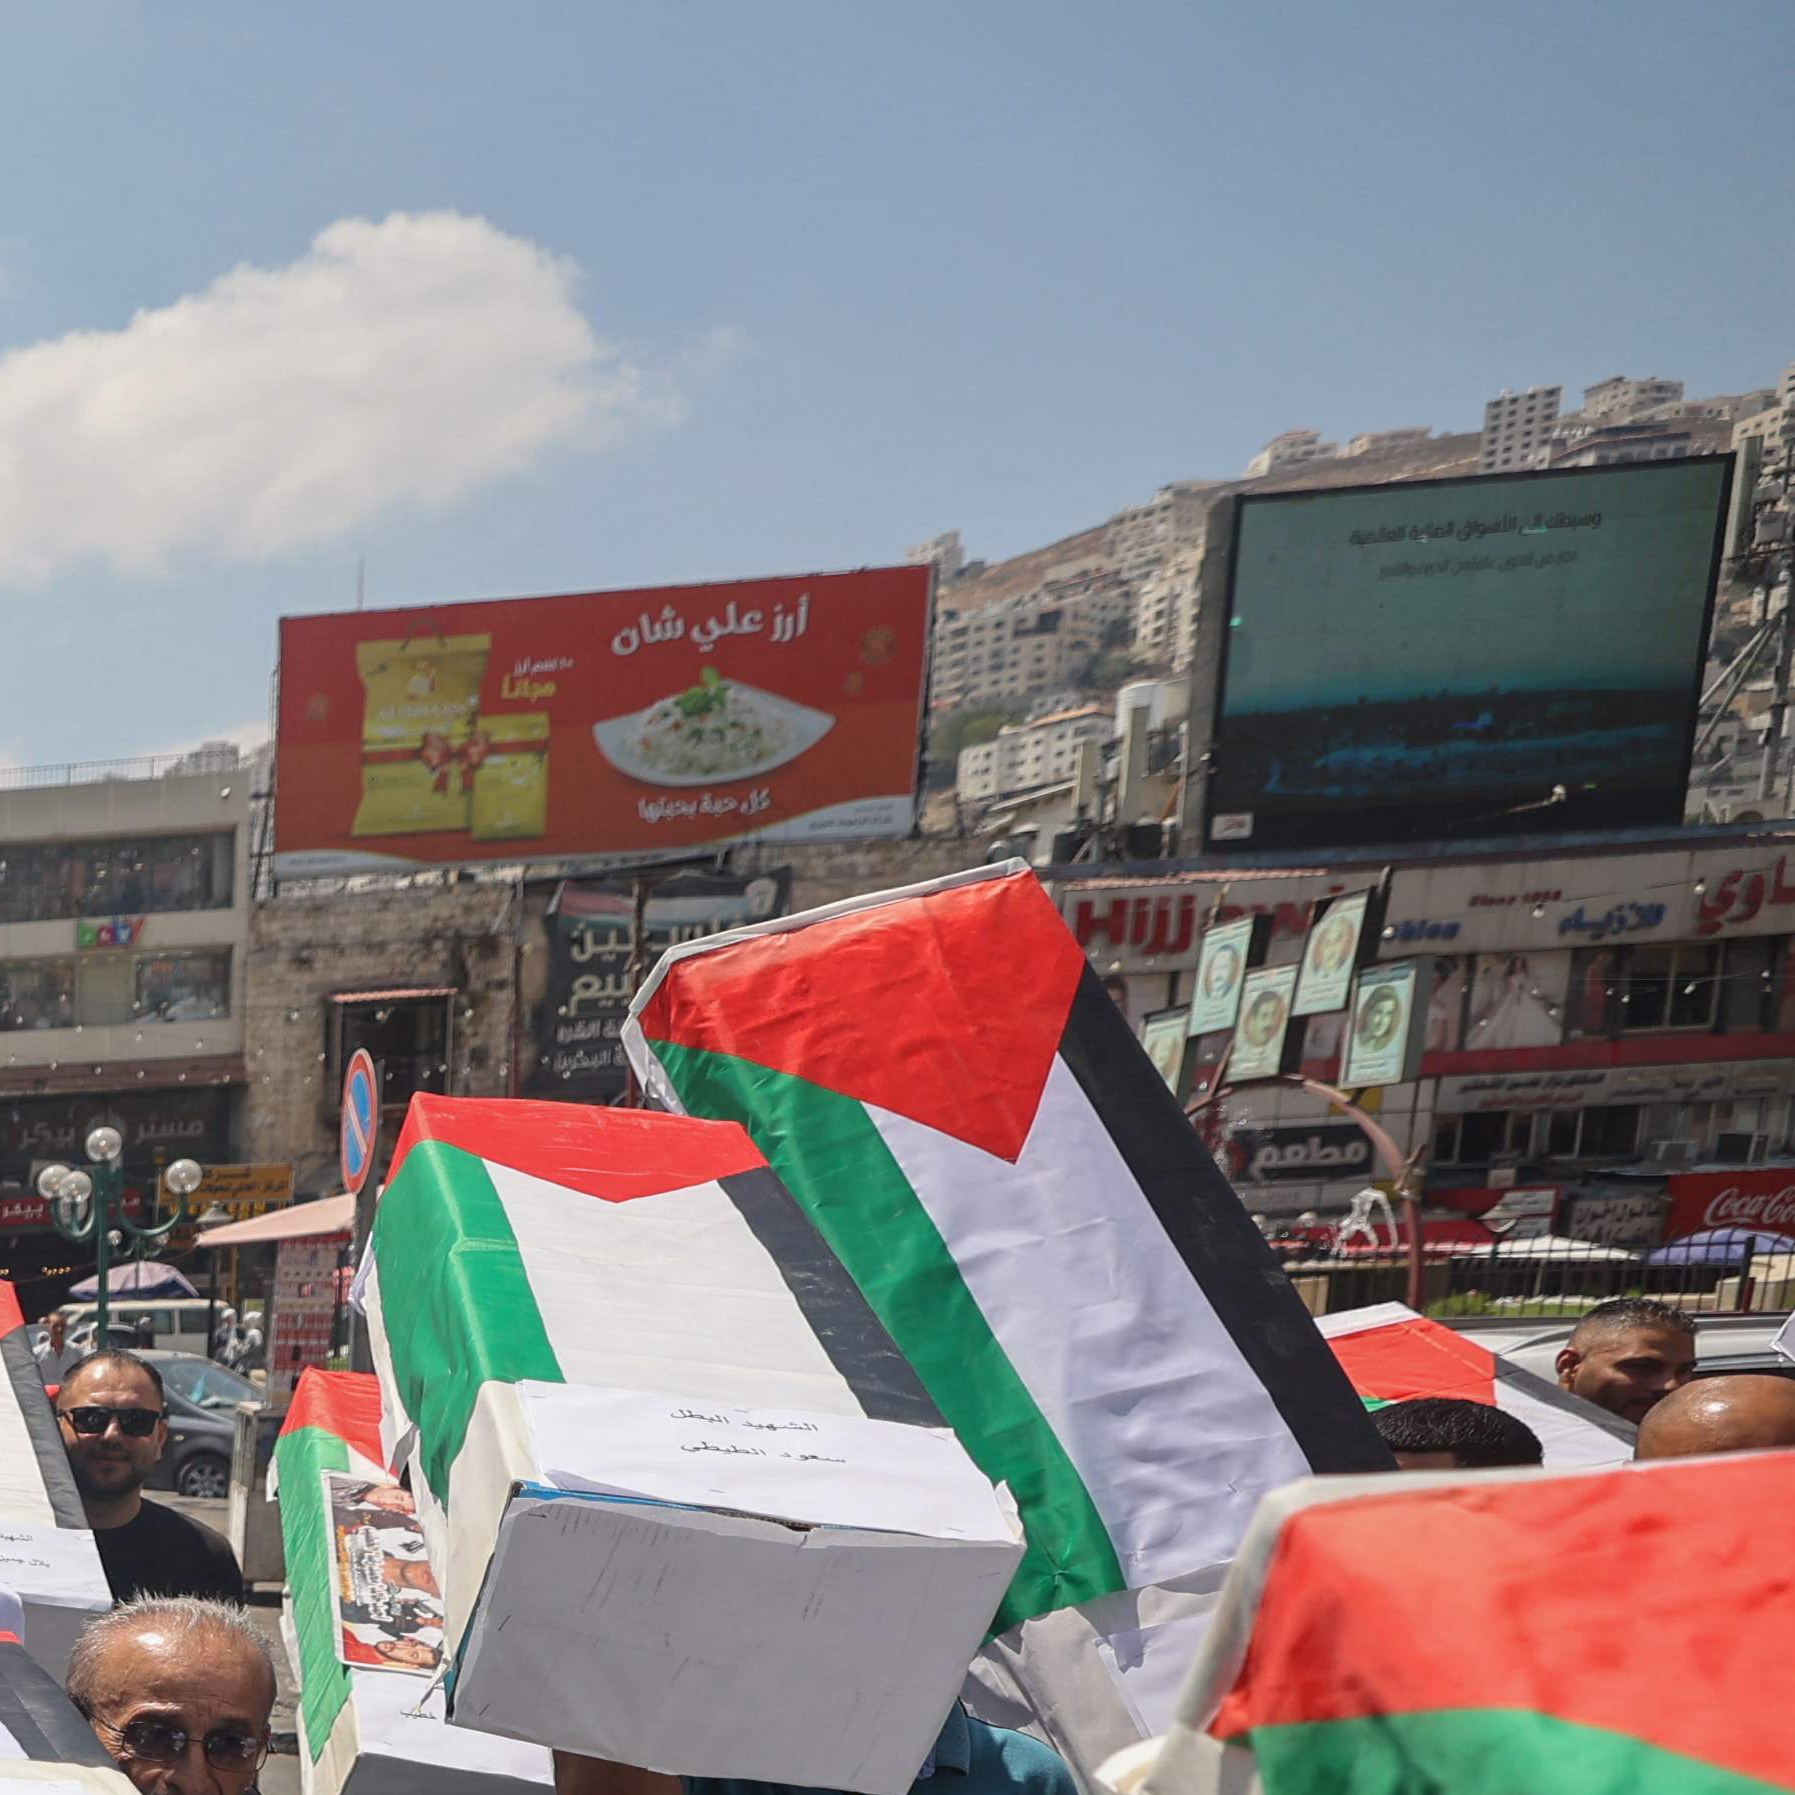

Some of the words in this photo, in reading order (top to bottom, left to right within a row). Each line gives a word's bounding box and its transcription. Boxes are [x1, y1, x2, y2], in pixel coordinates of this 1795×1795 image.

[611, 605, 686, 656] شان
[690, 601, 764, 652] علي
[1248, 1135, 1369, 1183] مطعم
[669, 1407, 730, 1424] البطل
[742, 1420, 819, 1433] الشهيد
